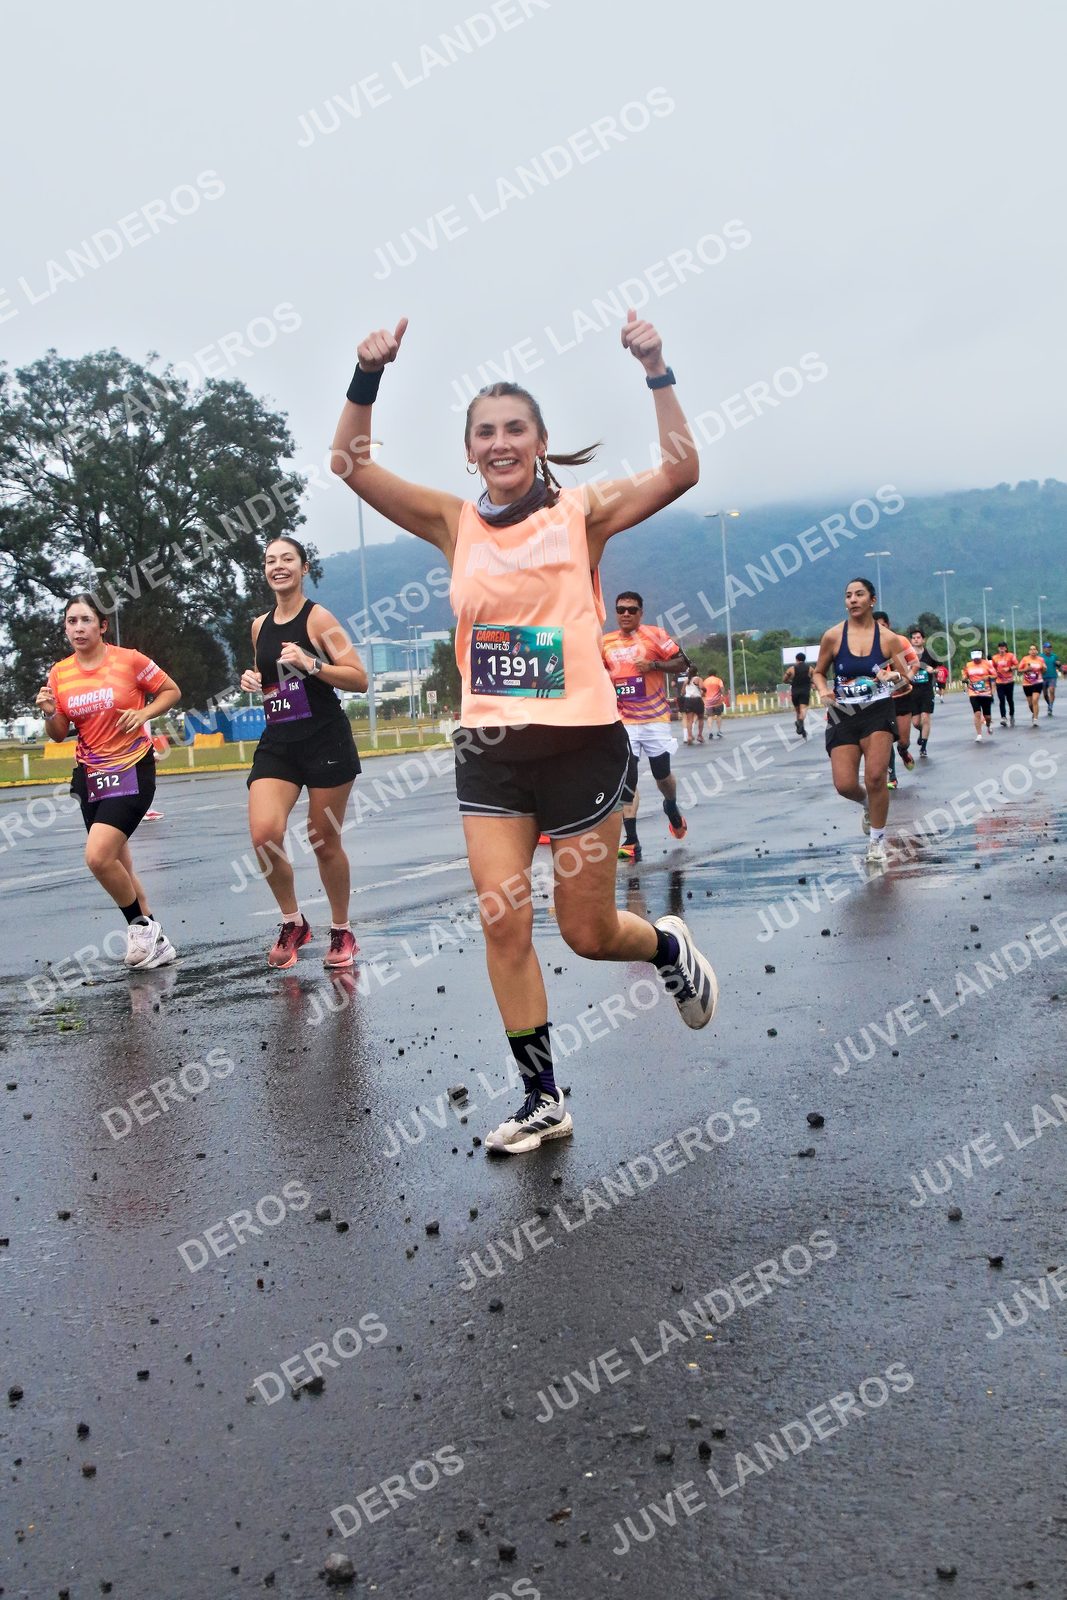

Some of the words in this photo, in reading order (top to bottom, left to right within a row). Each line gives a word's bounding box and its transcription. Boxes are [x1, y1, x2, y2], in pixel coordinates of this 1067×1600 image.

[476, 630, 510, 642] CARRERA
[536, 632, 555, 646] 10K
[487, 655, 539, 677] 1391
[288, 681, 300, 691] 15K
[620, 686, 636, 695] 233
[68, 687, 114, 708] CARRERA
[270, 698, 291, 712] 274
[96, 775, 120, 790] 512
